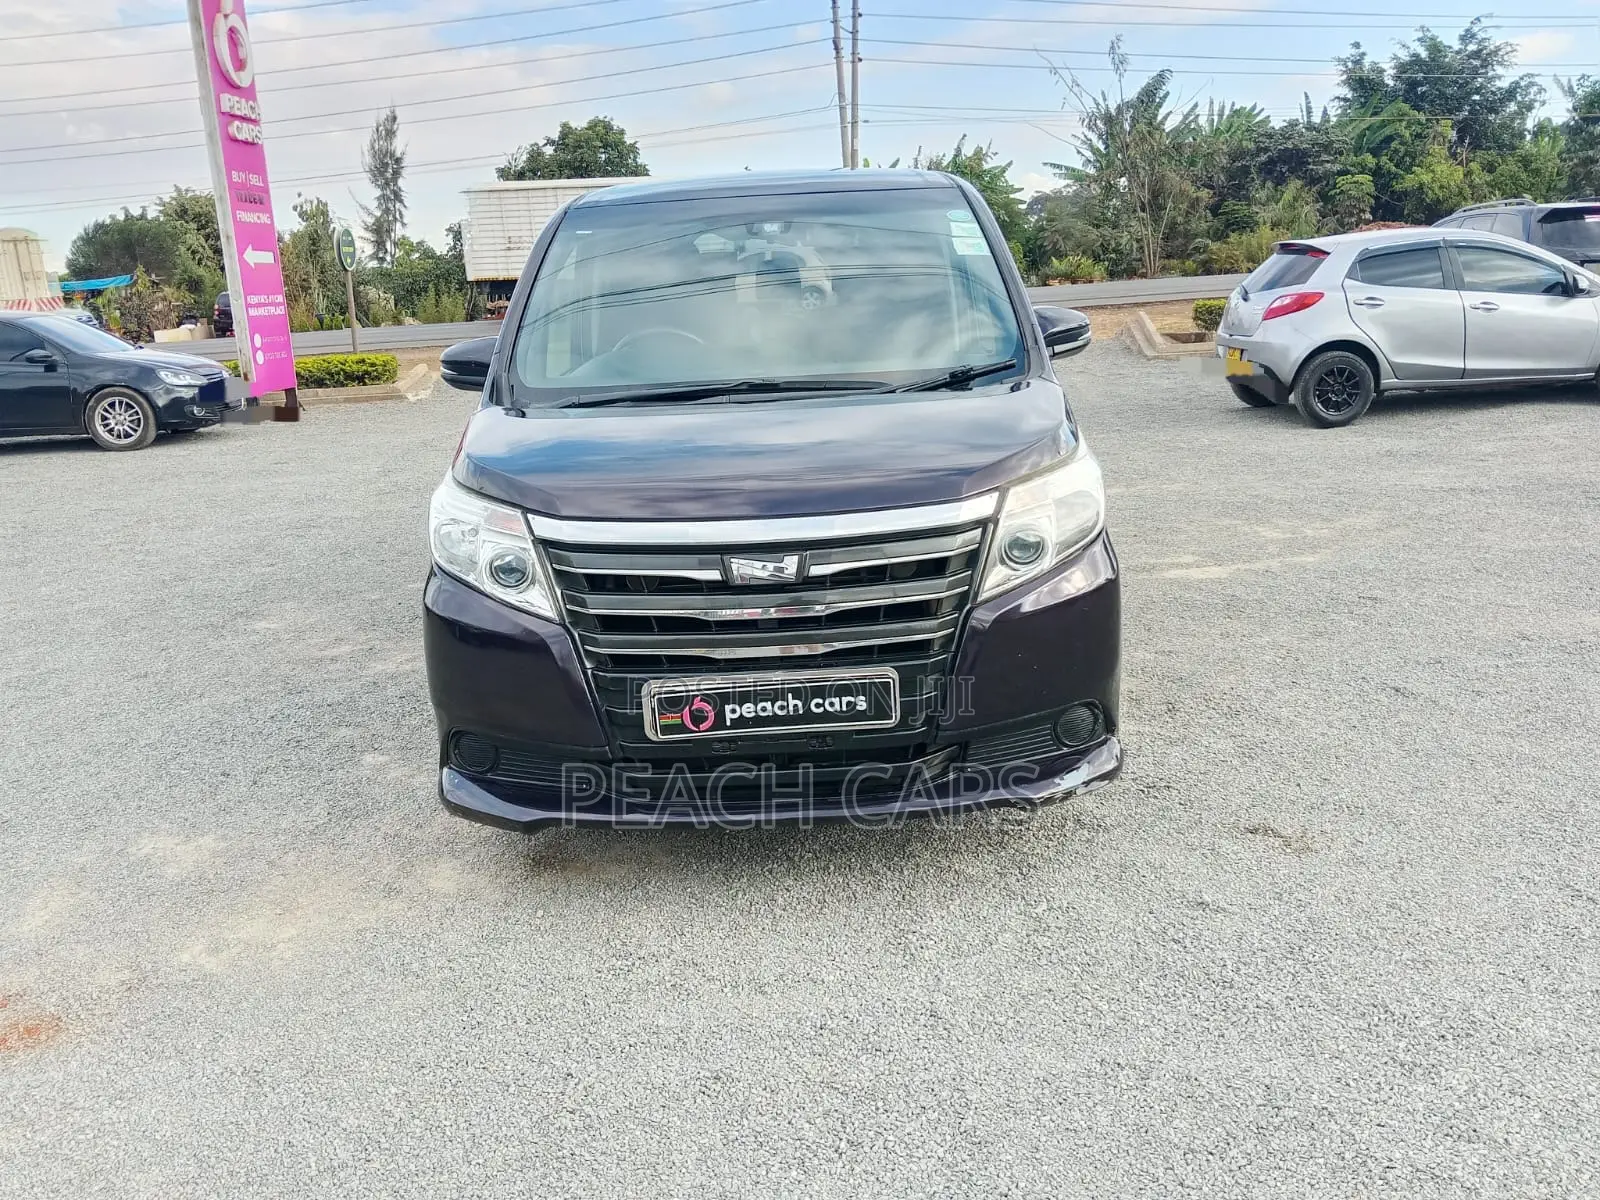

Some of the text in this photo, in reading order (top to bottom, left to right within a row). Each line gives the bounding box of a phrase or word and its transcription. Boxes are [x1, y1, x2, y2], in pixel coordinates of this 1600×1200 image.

[228, 121, 262, 144] CARS
[231, 170, 246, 183] BUY
[249, 174, 264, 187] SELL
[236, 210, 271, 224] FINANCING
[724, 693, 868, 726] peach cars
